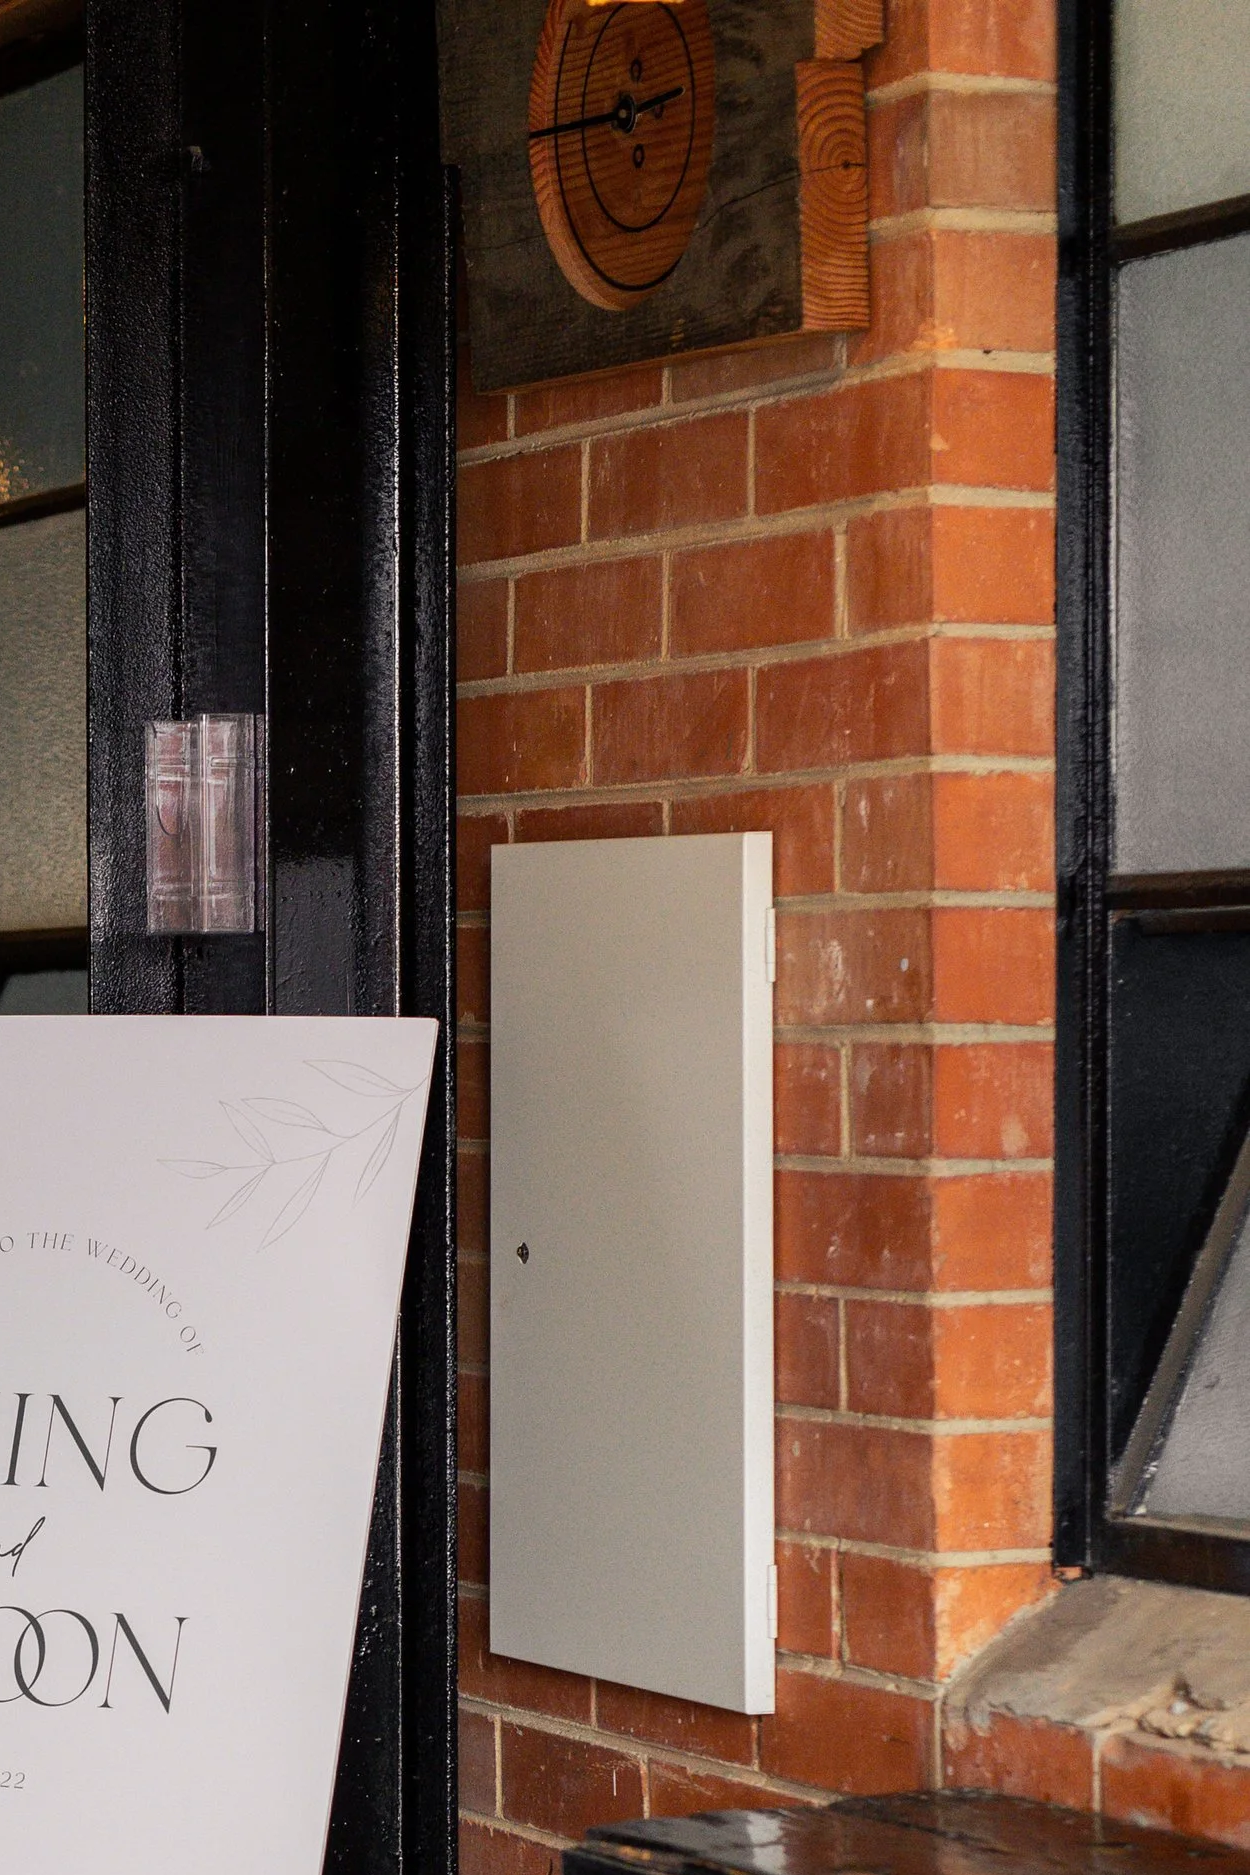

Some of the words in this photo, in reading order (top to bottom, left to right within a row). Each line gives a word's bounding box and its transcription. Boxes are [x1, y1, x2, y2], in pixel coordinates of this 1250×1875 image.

[27, 1231, 75, 1252] THE
[86, 1238, 182, 1319] WEDDING
[179, 1325, 205, 1355] OF
[0, 1770, 26, 1789] 22
